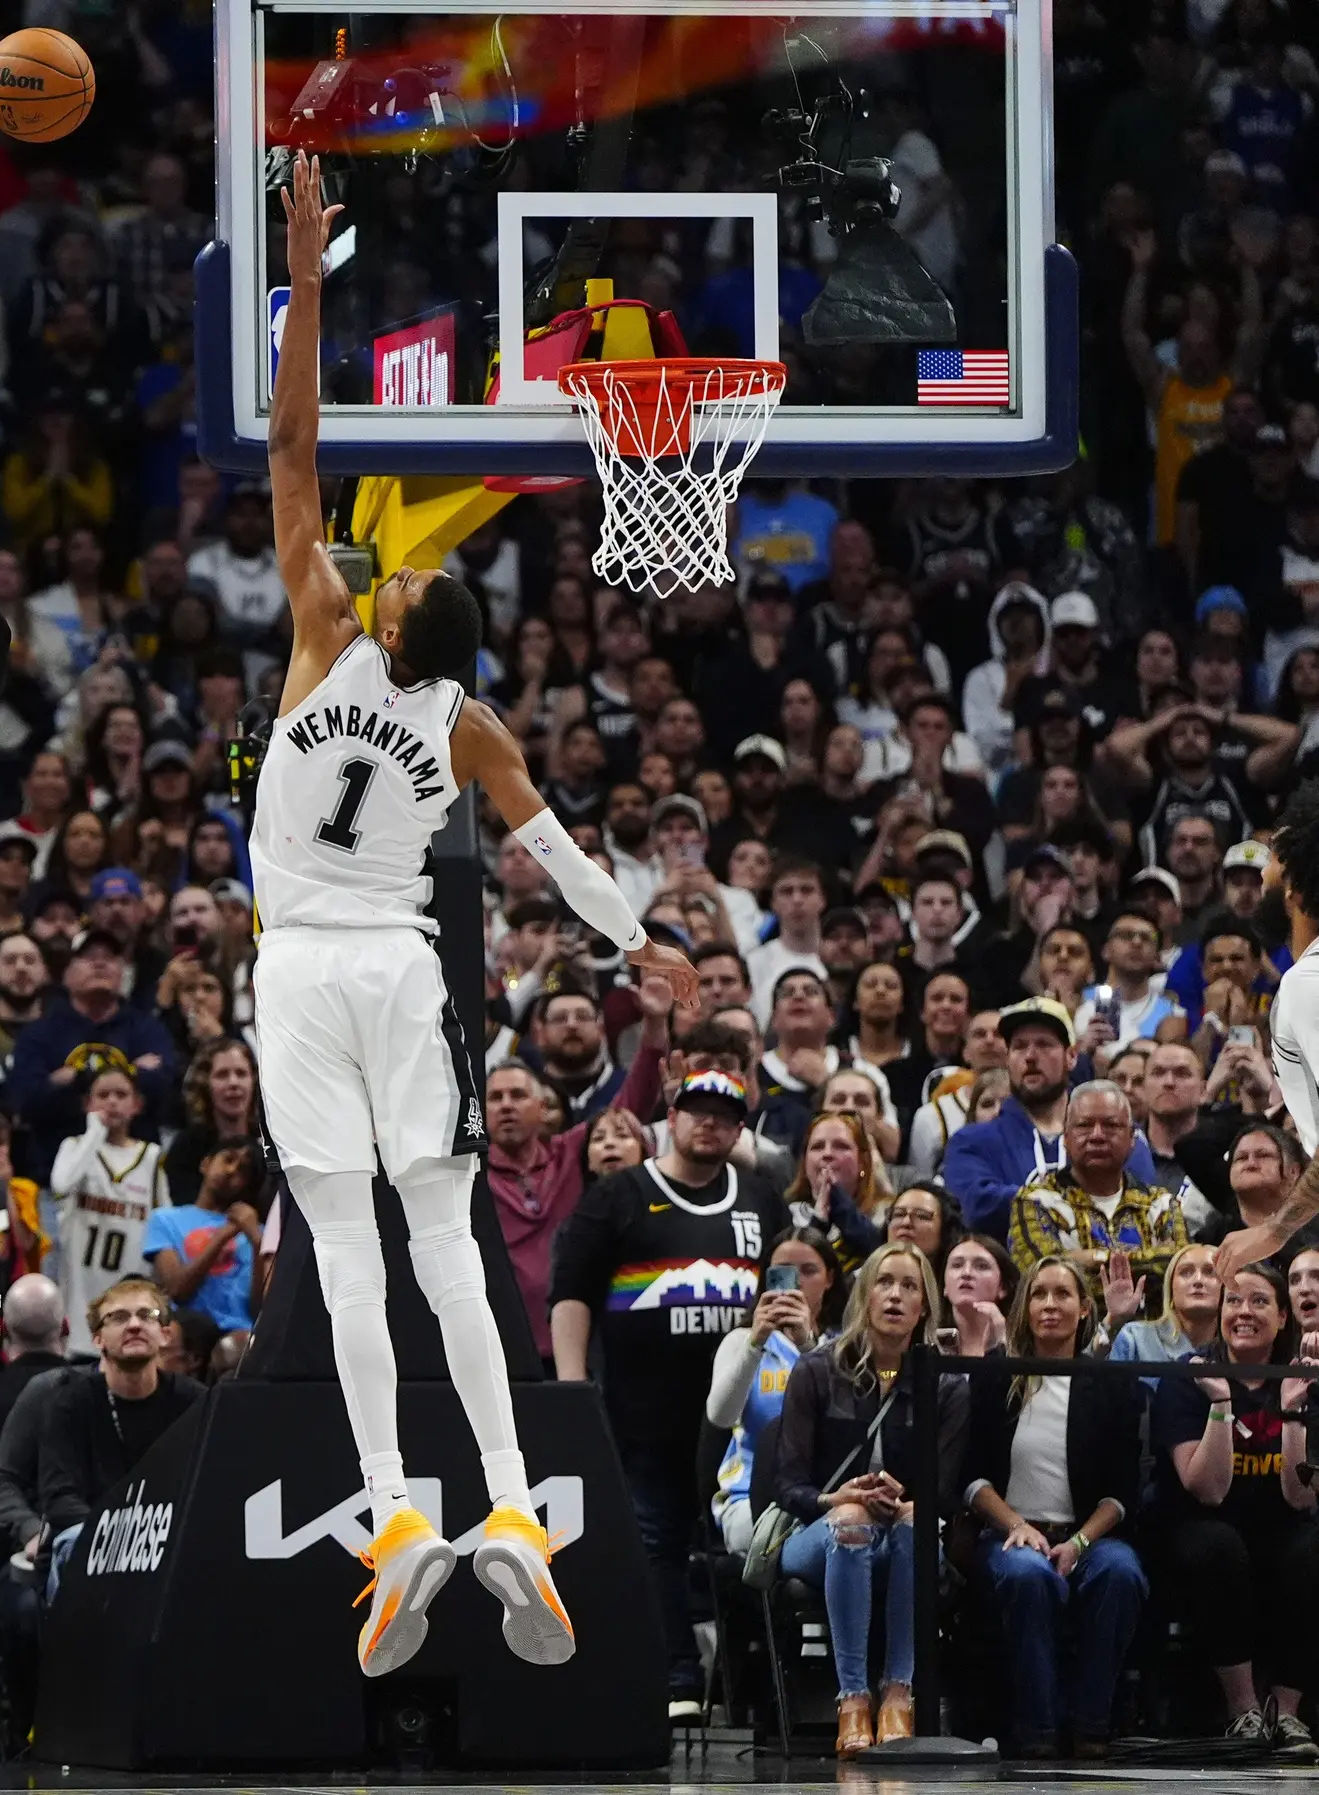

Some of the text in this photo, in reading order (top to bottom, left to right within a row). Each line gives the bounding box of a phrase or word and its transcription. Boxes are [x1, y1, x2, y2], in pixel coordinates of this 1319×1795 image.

[286, 705, 444, 802] WEMBANYAMA
[313, 755, 379, 855] 1
[84, 1226, 126, 1270] 10
[731, 1219, 763, 1260] 15
[670, 1306, 749, 1335] DENVE
[86, 1478, 174, 1576] coinbase
